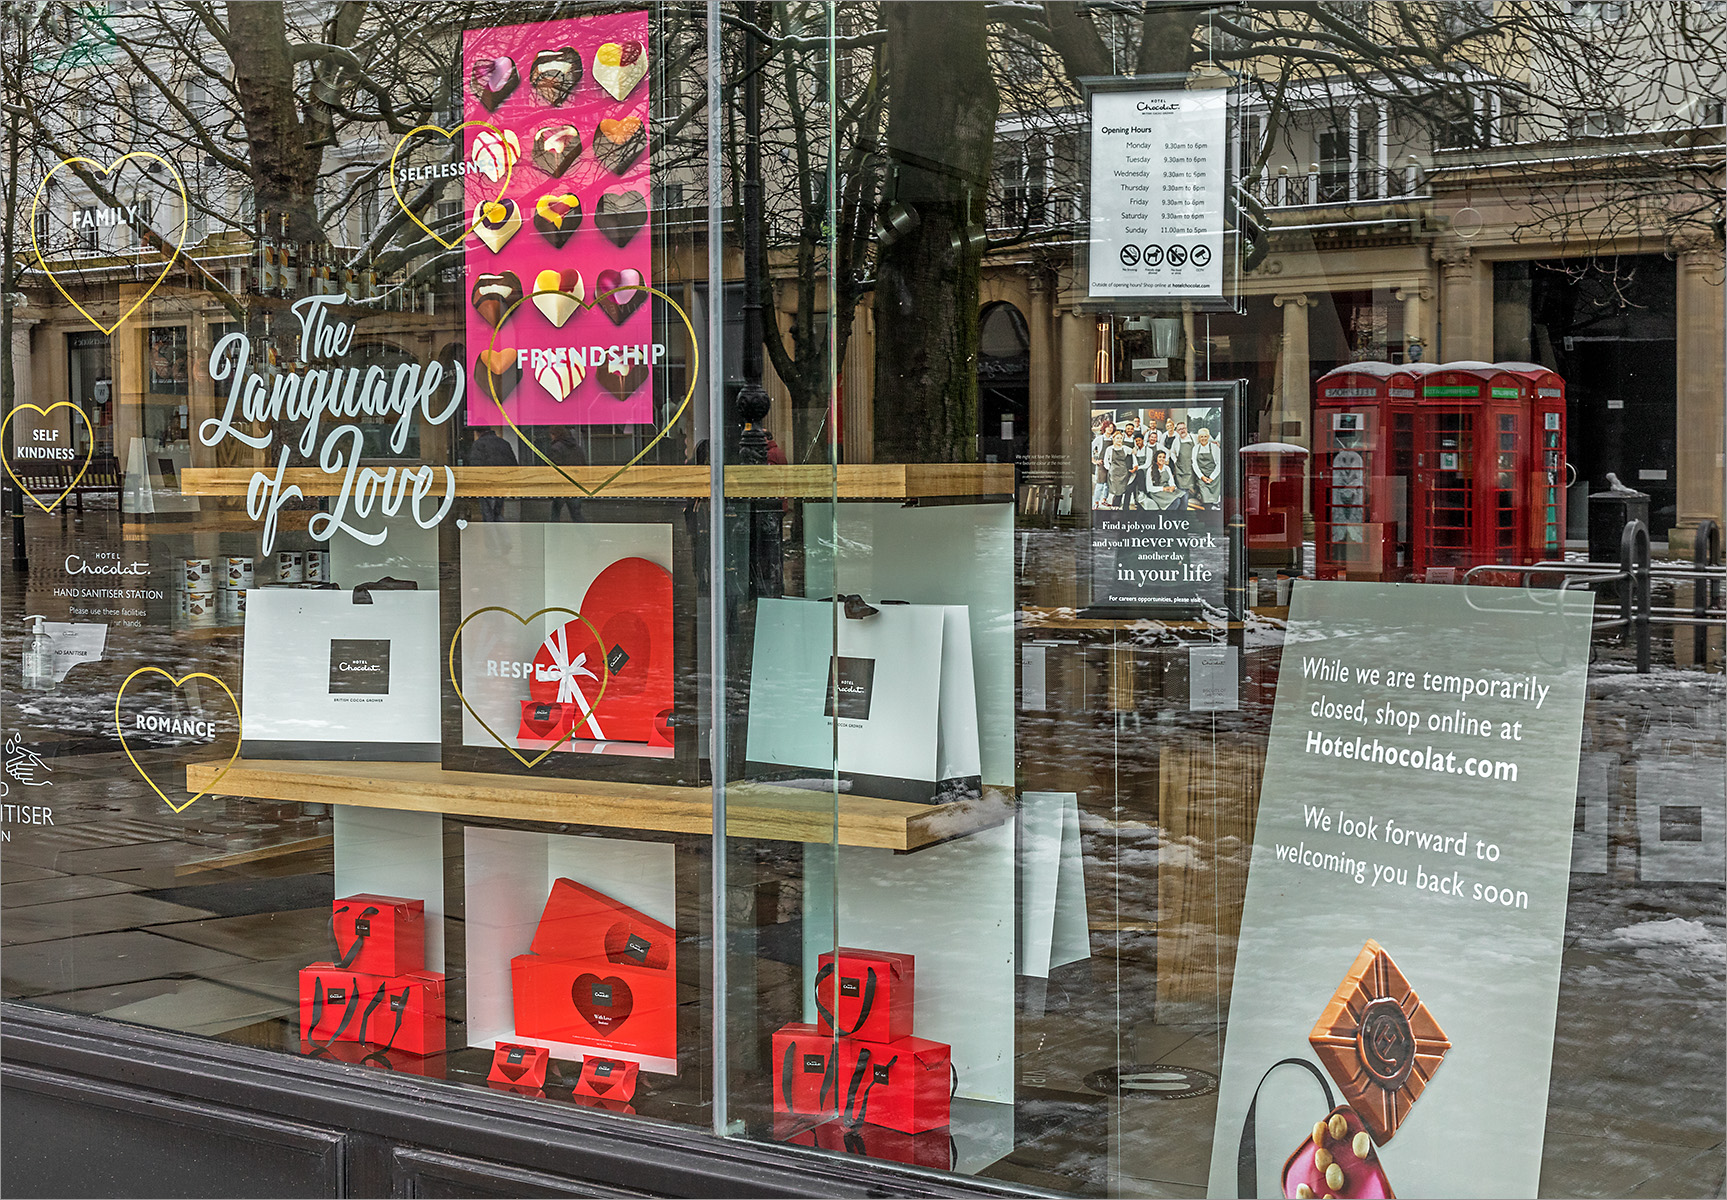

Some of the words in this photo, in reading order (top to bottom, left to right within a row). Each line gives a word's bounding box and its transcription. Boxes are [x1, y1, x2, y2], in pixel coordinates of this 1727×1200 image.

[1102, 127, 1129, 135] Opening
[1126, 142, 1151, 150] Monday
[1126, 156, 1151, 164] Tuesday
[1114, 170, 1150, 178] Wednesday
[1121, 184, 1149, 192] Thursday
[1130, 198, 1148, 206] Friday
[1192, 199, 1204, 207] 6pm
[72, 206, 138, 230] FAMILY
[1121, 212, 1148, 220] Saturday
[291, 292, 355, 363] The
[517, 344, 666, 369] FRIENDSHIP
[199, 333, 465, 458] Language
[33, 429, 58, 441] SELF
[18, 447, 74, 460] KINDNESS
[246, 444, 303, 557] of
[1102, 521, 1120, 530] Find
[1126, 521, 1140, 532] job
[1141, 524, 1155, 532] you
[1159, 515, 1189, 530] love
[1093, 539, 1107, 547] and
[1108, 539, 1129, 549] you'll
[1131, 537, 1174, 547] never
[1176, 533, 1216, 547] work
[1138, 552, 1170, 560] another
[1170, 552, 1184, 564] day
[1118, 563, 1135, 581] in
[1138, 569, 1179, 587] your
[1183, 564, 1212, 581] life
[53, 588, 79, 598] HAND
[81, 588, 124, 599] SANITISER
[126, 589, 163, 599] STATION
[69, 606, 88, 615] Please
[122, 608, 146, 616] facilities
[1302, 656, 1349, 683] While
[1356, 667, 1379, 685] we
[1386, 670, 1415, 689] are
[1423, 671, 1550, 709] temporarily
[136, 714, 216, 738] ROMANCE
[1311, 695, 1368, 726] closed,
[1375, 702, 1420, 735] shop
[1428, 710, 1491, 737] online
[1501, 721, 1522, 741] at
[1305, 730, 1518, 782] Hotelchocolat.com
[1304, 804, 1331, 831] We
[1338, 811, 1378, 841] look
[1385, 820, 1467, 856] forward
[1476, 839, 1500, 862] to
[1275, 841, 1366, 884] welcoming
[1371, 863, 1407, 886] you
[1416, 864, 1464, 897] back
[1472, 883, 1528, 909] soon
